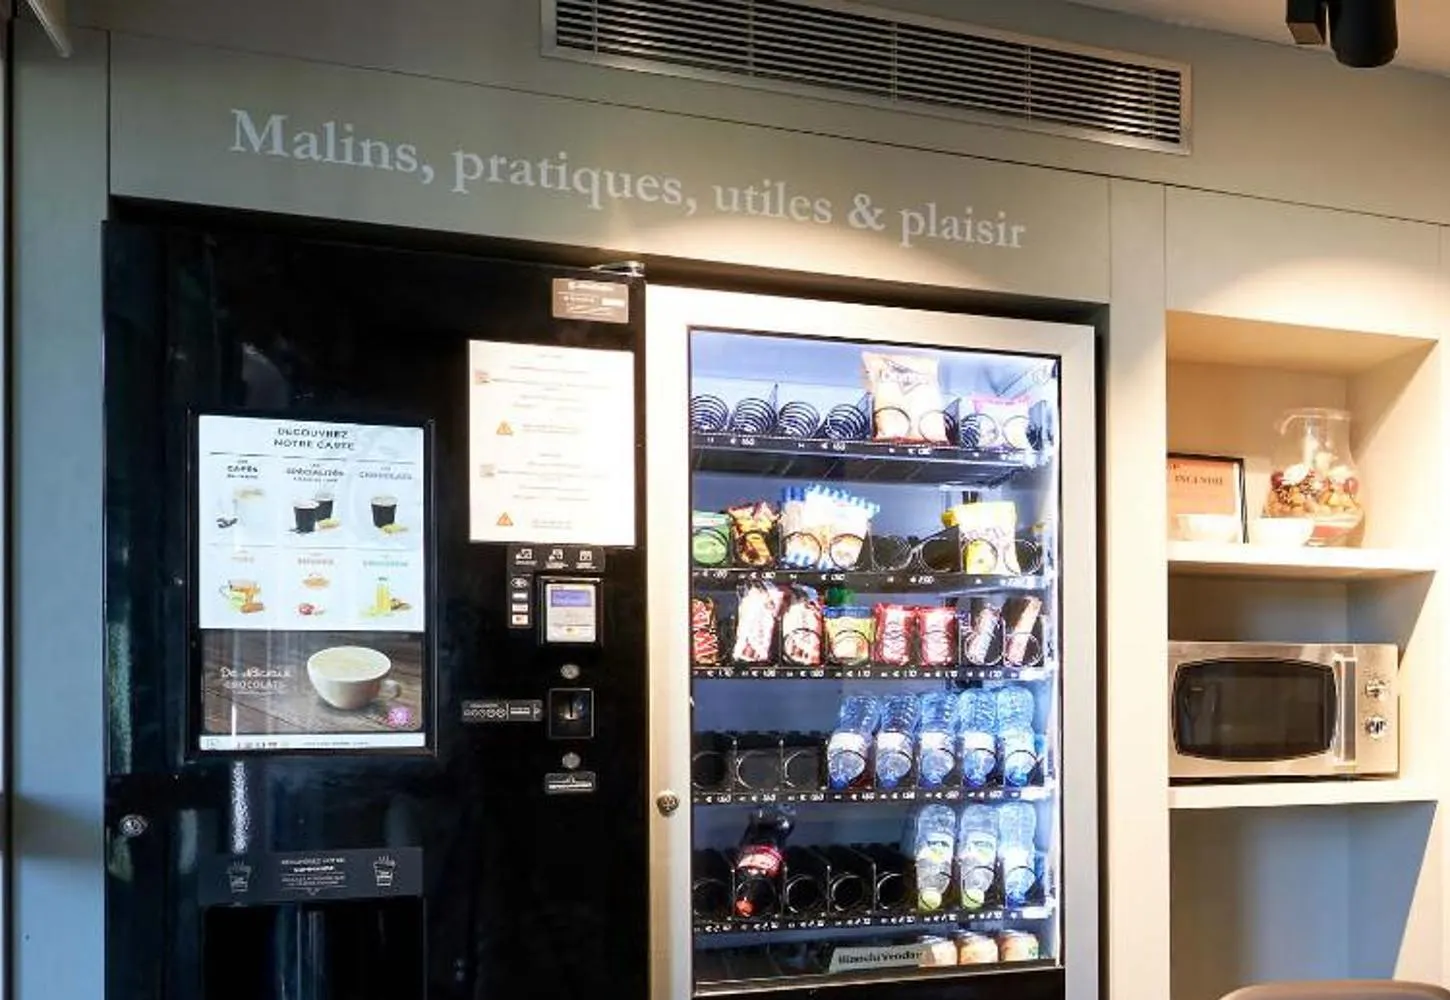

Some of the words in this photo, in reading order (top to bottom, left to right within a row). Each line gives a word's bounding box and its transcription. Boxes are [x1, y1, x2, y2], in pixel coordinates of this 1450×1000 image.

[229, 108, 436, 185] Malins,
[453, 142, 699, 217] pratiques,
[714, 180, 832, 226] utiles
[848, 194, 886, 231] &
[901, 202, 1027, 249] plaisir
